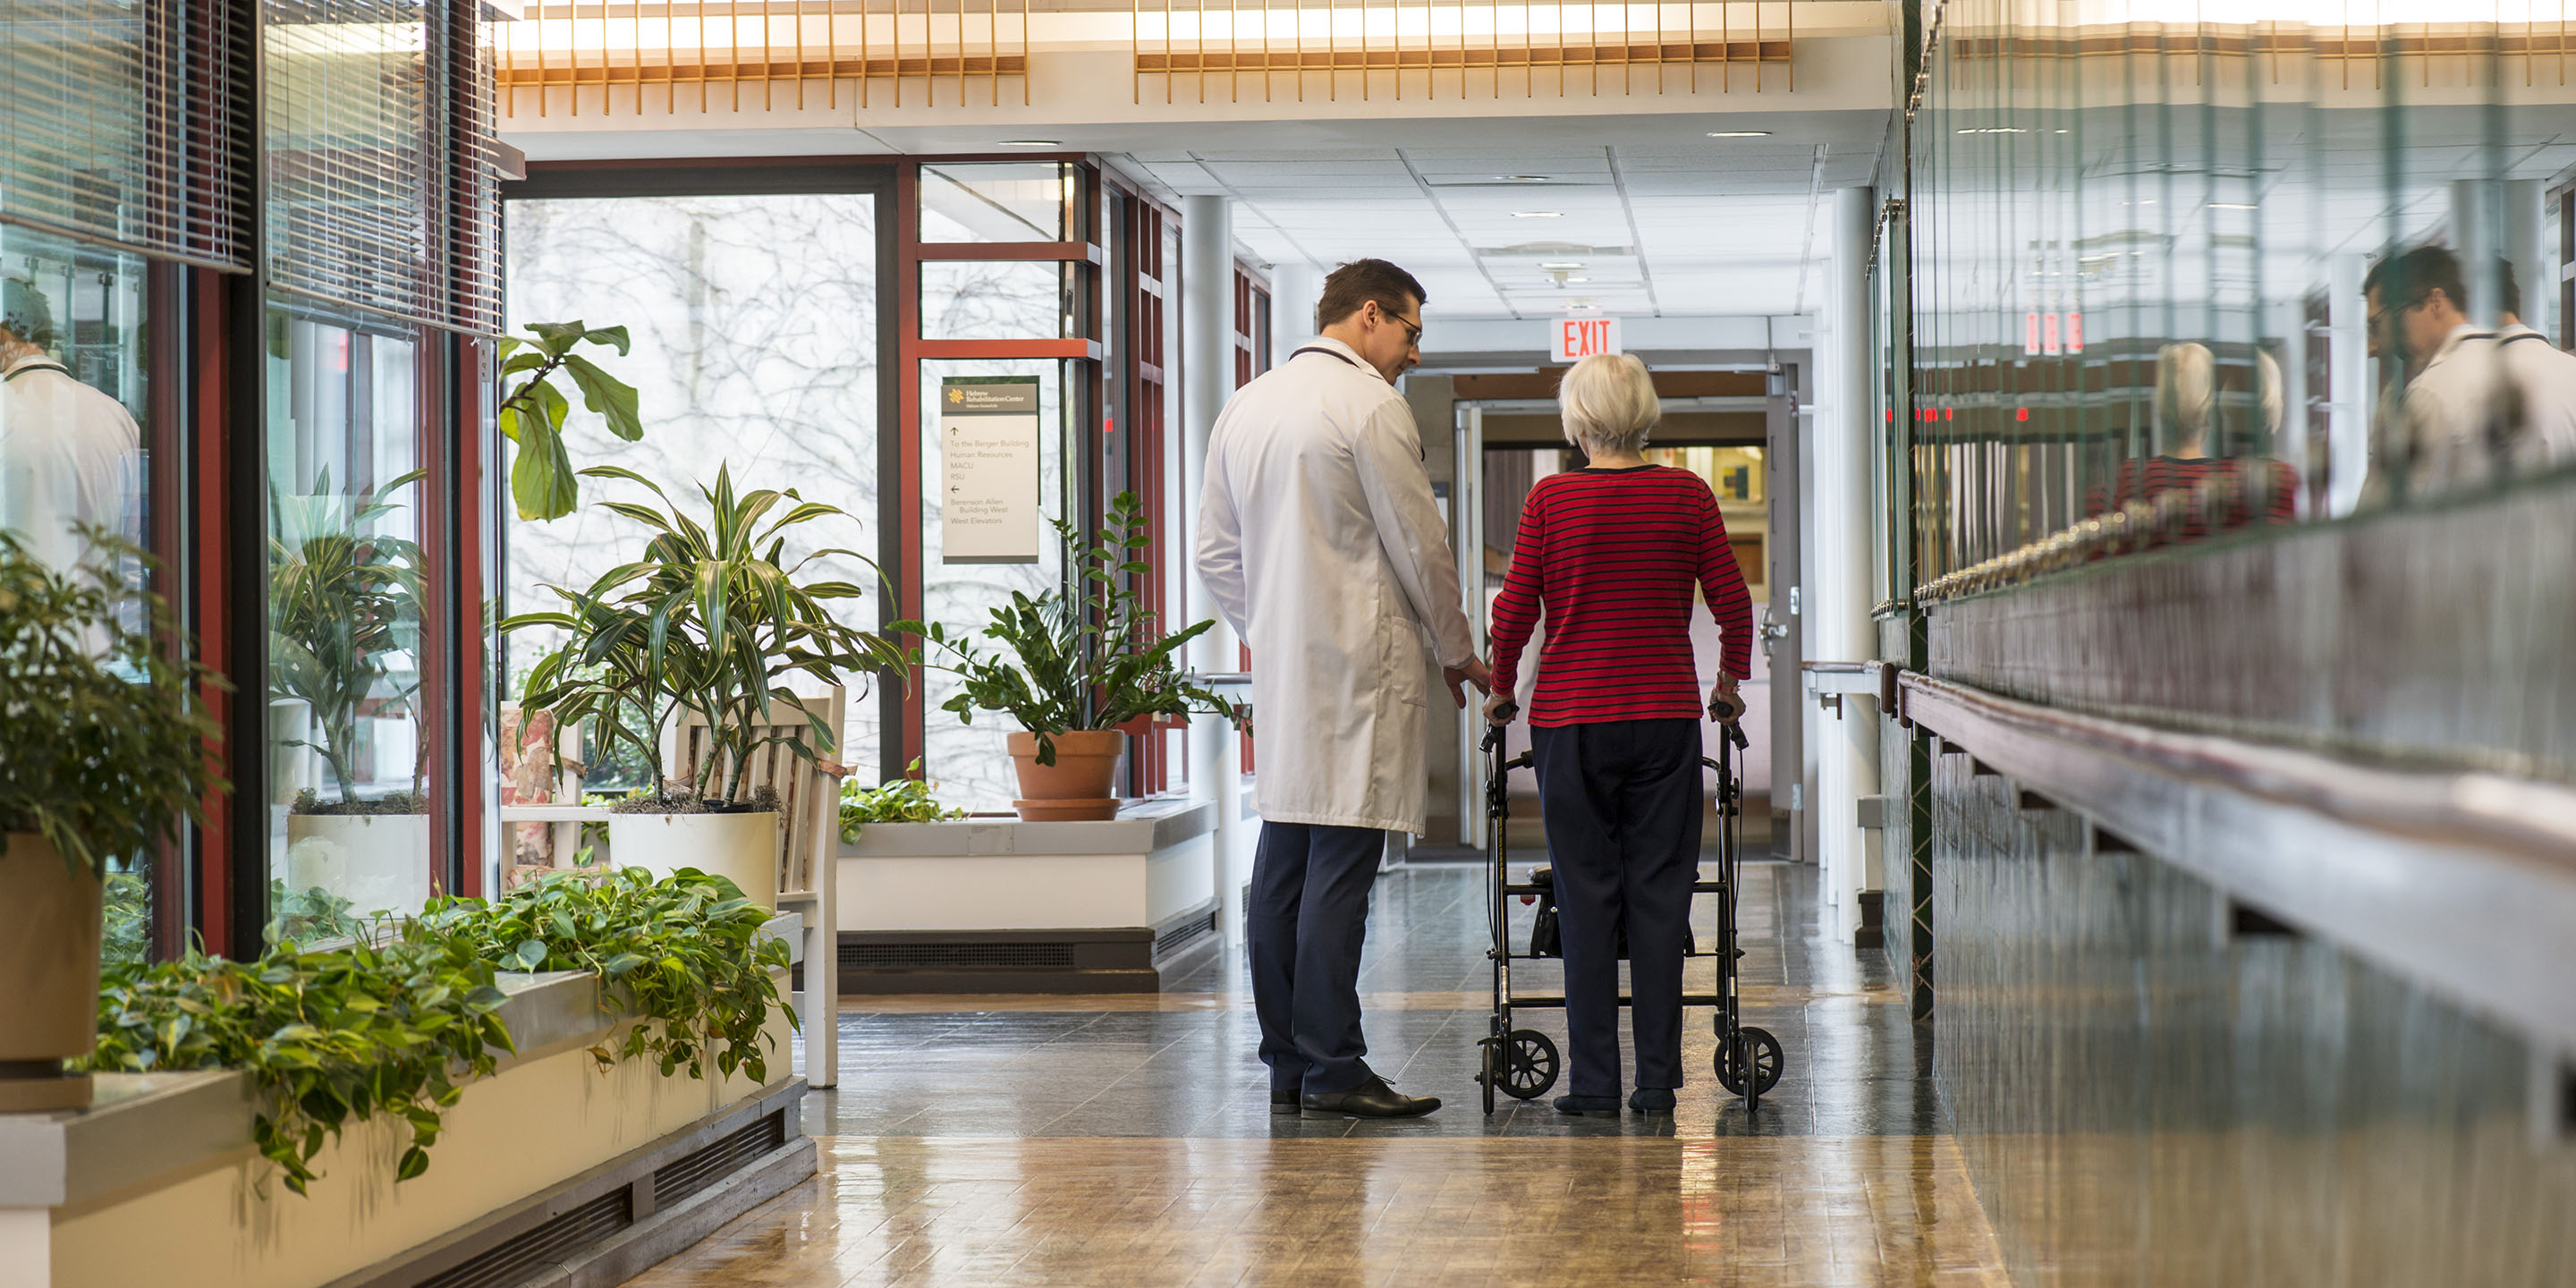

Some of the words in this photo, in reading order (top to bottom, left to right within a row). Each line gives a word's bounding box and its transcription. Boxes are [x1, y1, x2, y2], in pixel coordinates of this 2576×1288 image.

[1563, 320, 1610, 357] EXIT
[975, 440, 998, 449] Berger
[1001, 440, 1030, 448] Building
[950, 462, 973, 470] MACU
[960, 506, 988, 514] Building
